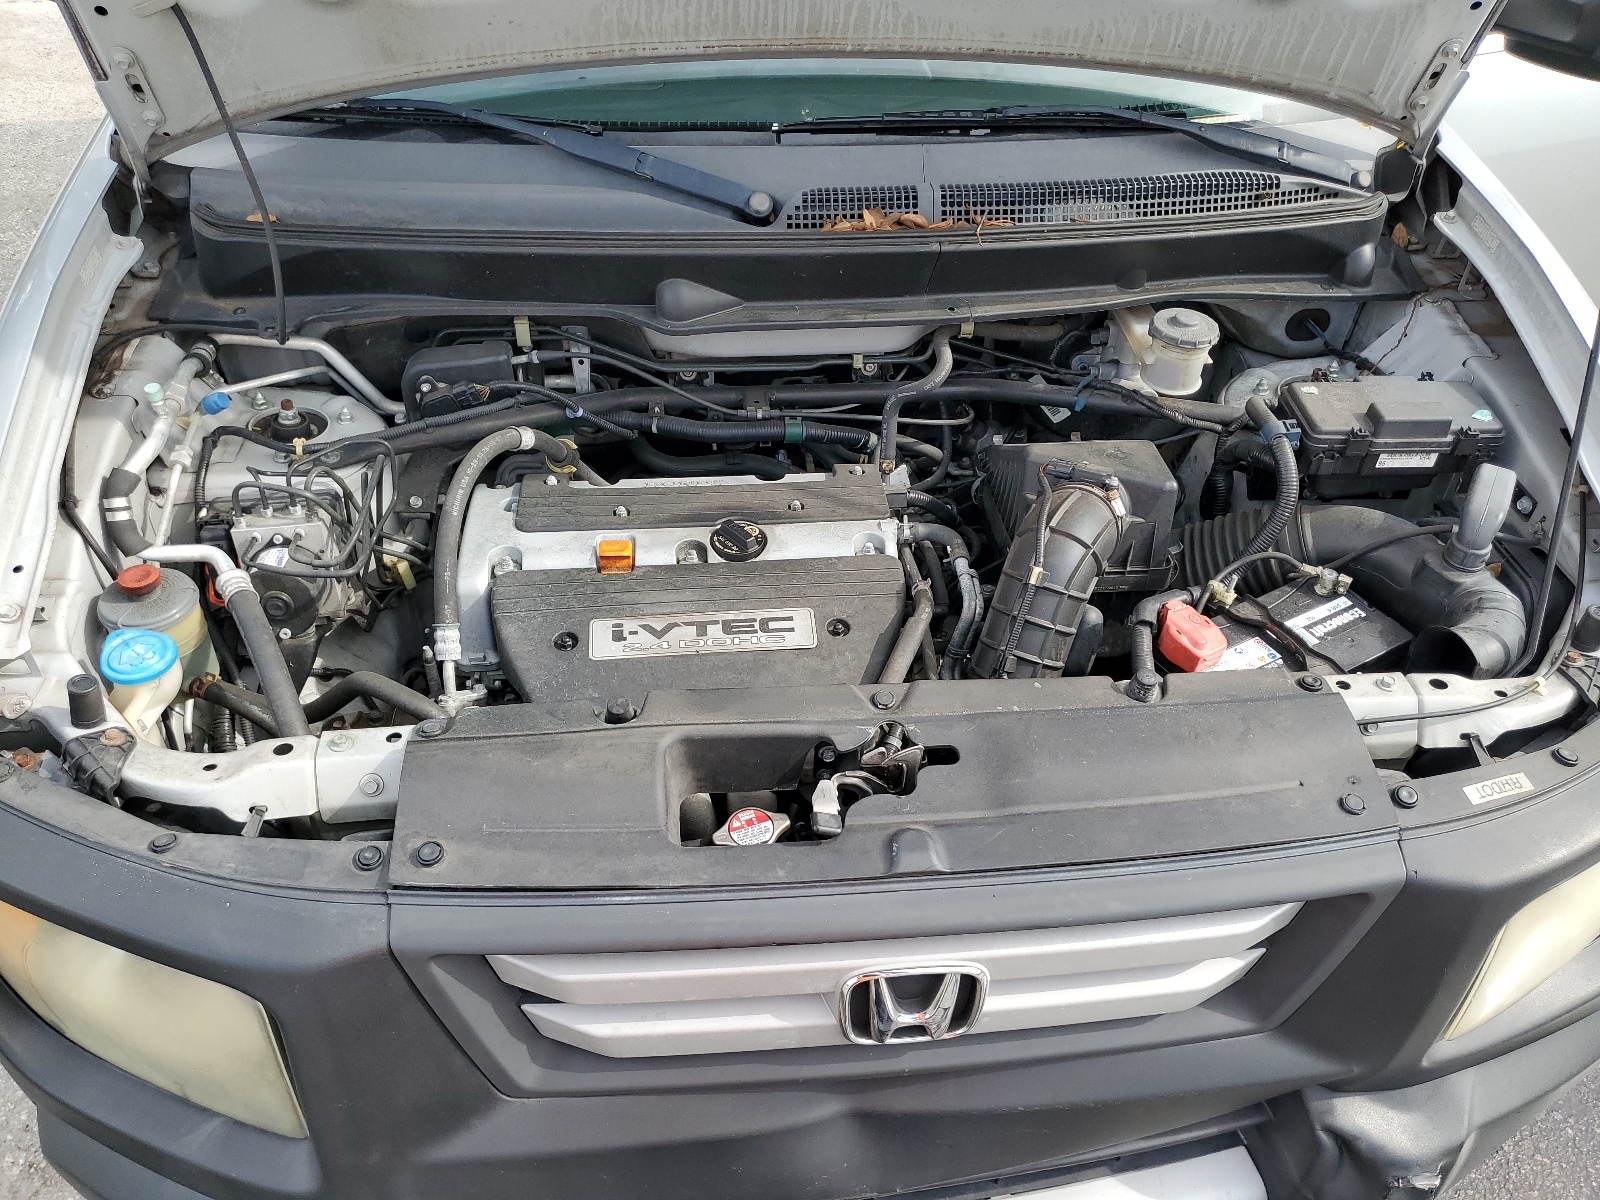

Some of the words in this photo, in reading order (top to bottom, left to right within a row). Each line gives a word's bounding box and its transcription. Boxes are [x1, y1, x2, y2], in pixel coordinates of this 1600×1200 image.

[611, 615, 795, 643] i-VTEC
[622, 640, 672, 652] 2.4
[678, 634, 786, 649] DOHC
